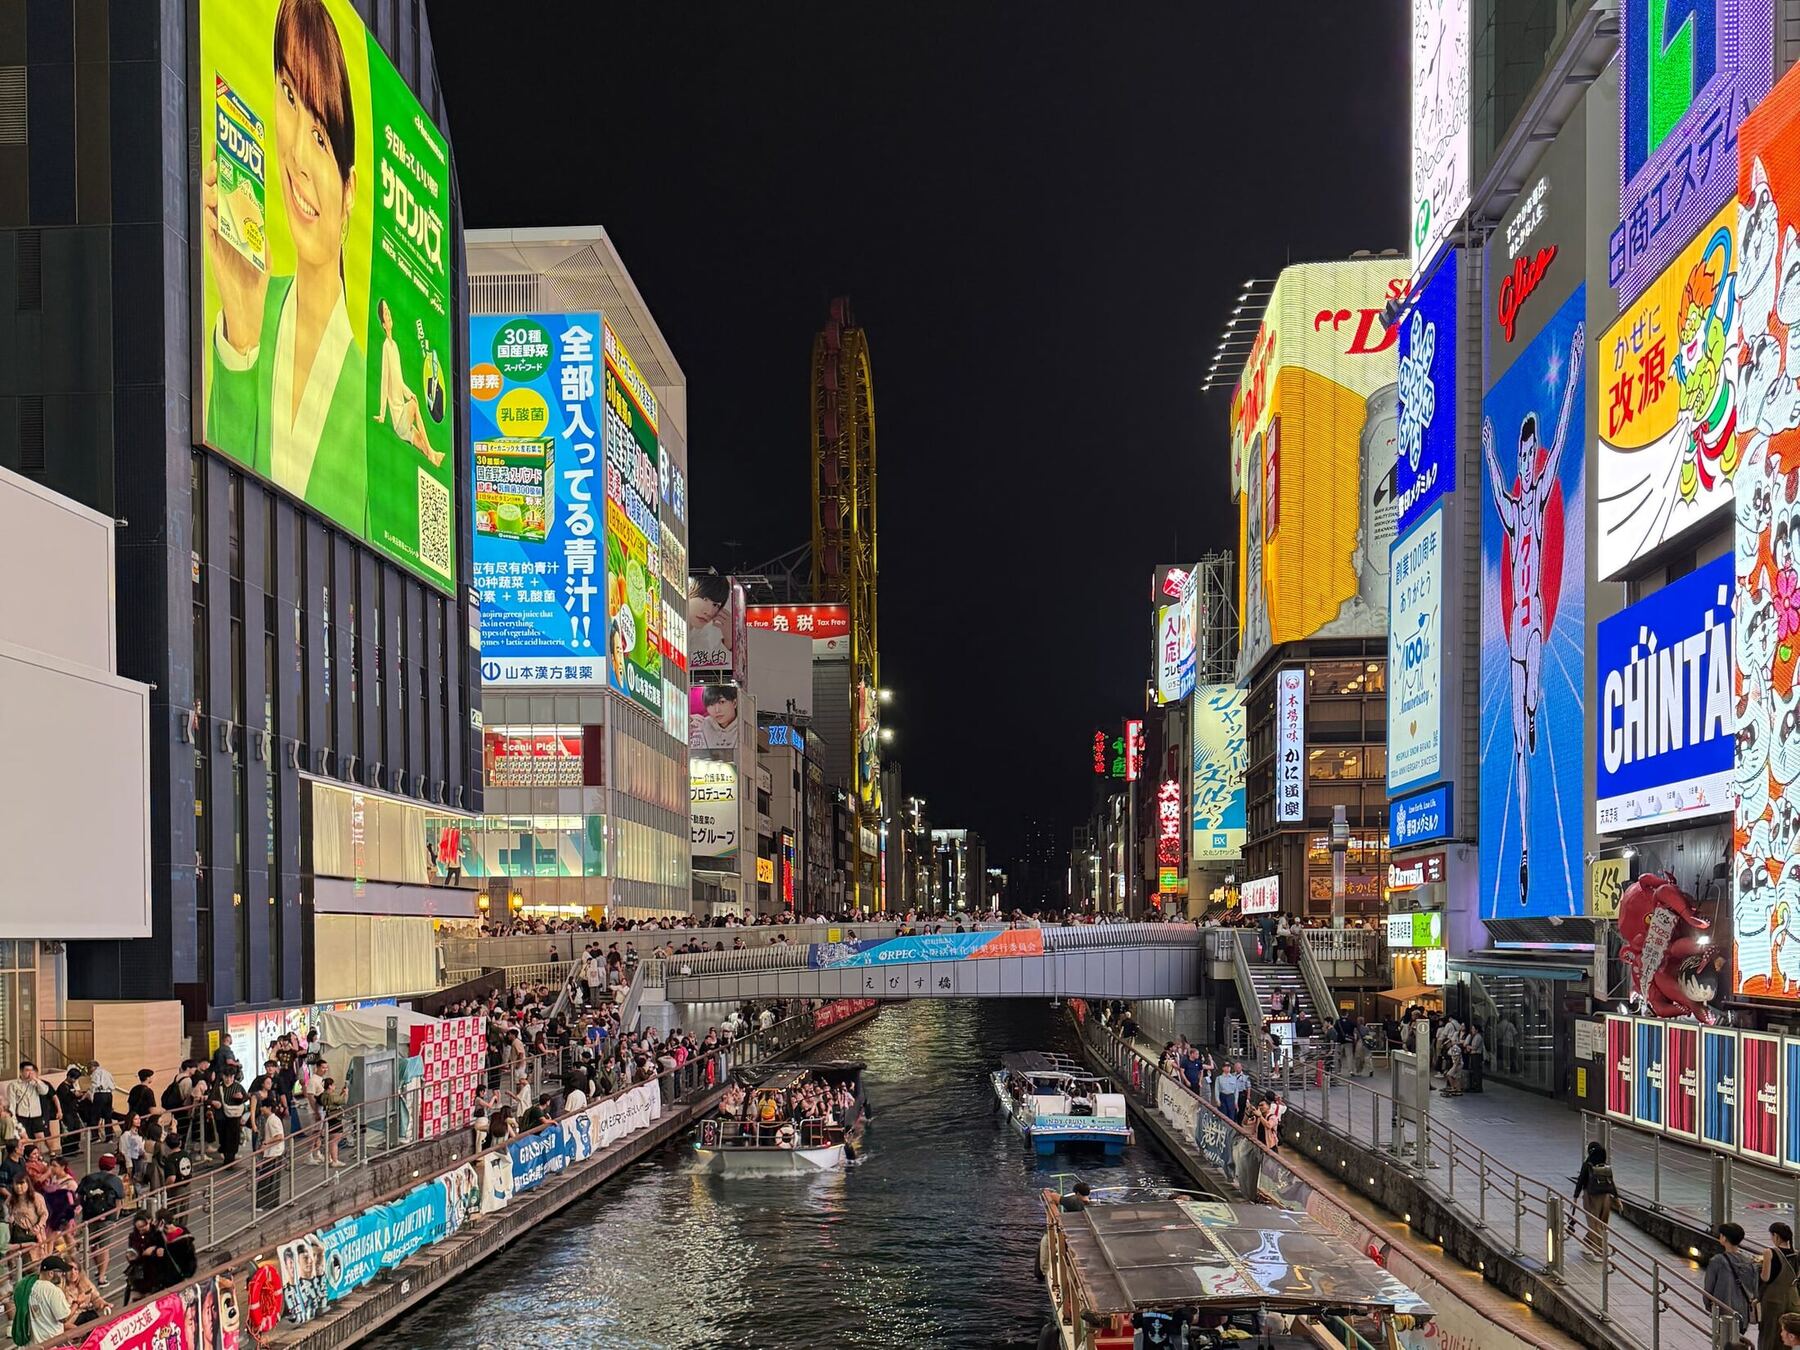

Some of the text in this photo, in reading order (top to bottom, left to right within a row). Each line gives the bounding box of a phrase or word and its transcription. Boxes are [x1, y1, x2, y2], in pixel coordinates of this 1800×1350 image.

[219, 112, 264, 181] サロンパス
[381, 157, 445, 276] サロンパス
[1498, 245, 1557, 343] Glico
[497, 344, 548, 358] 国産野菜
[504, 328, 542, 345] 30種
[1614, 304, 1661, 372] かぜに
[470, 374, 501, 389] 酵素
[503, 362, 543, 373] スーパーフード
[1608, 335, 1666, 439] 改源
[500, 407, 545, 422] 乳酸菌
[480, 590, 496, 603] 素
[517, 589, 556, 603] 乳酸菌
[1400, 570, 1432, 613] ありがとう
[1520, 527, 1531, 628] グリコ
[773, 614, 814, 632] 免税
[505, 665, 593, 680] 山本漢方製薬
[1604, 616, 1736, 774] CHINTA
[1286, 694, 1299, 742] 本場の味
[865, 976, 952, 990] えびす橋
[110, 1308, 154, 1347] セレッソ大阪
